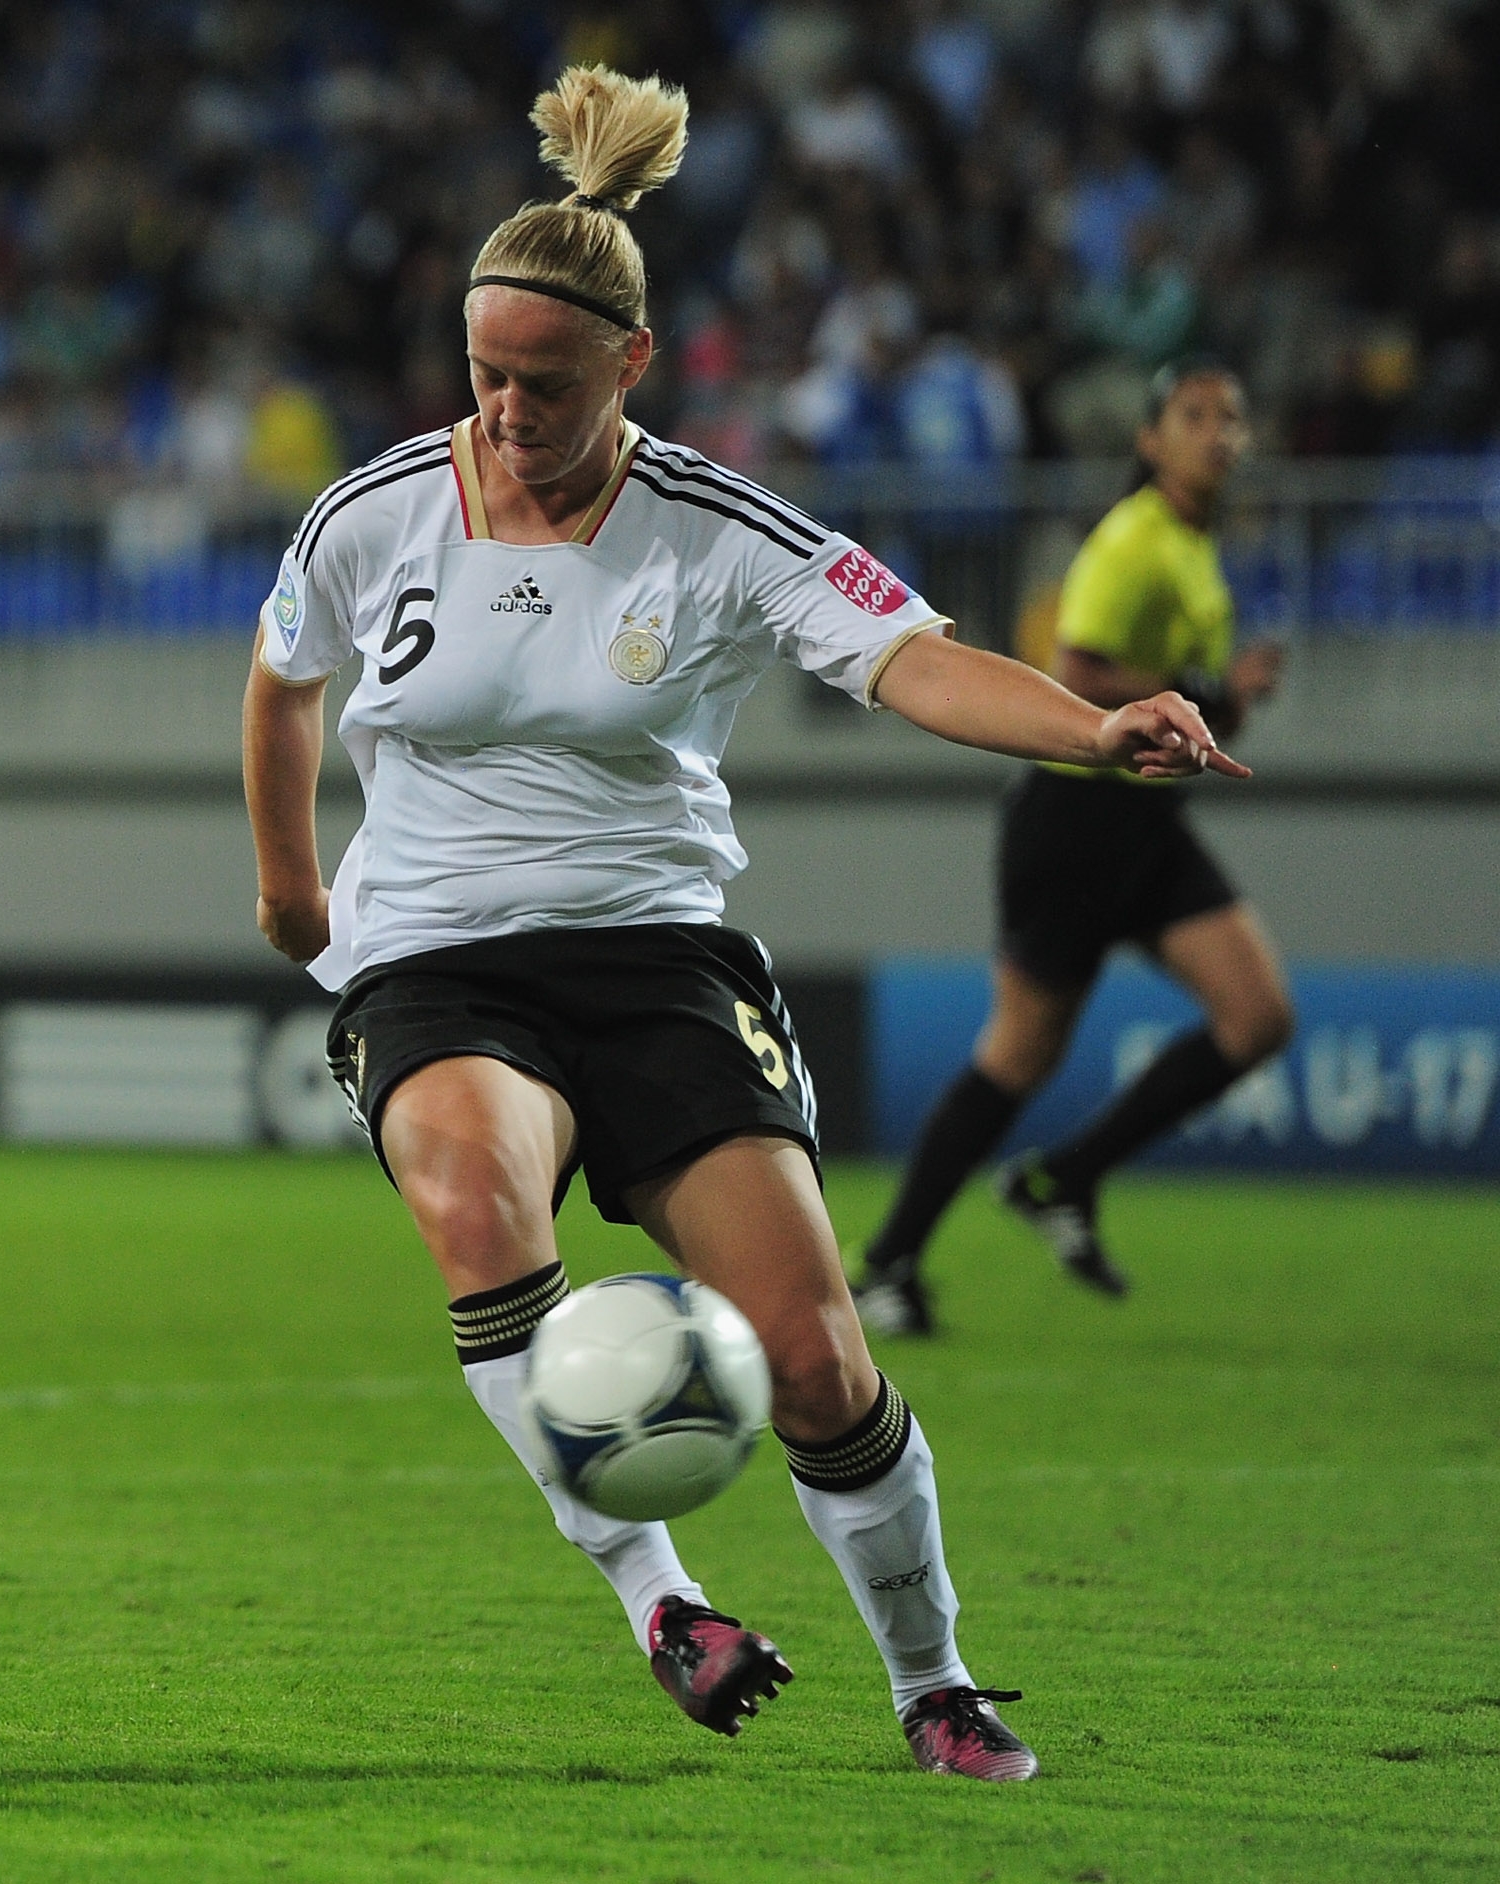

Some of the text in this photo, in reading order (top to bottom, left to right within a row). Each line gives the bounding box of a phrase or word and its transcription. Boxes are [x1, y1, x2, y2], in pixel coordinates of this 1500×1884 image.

[490, 599, 552, 615] adidas
[835, 550, 867, 592] LIVE
[379, 588, 435, 685] 5
[734, 1000, 789, 1090] 5
[1303, 1022, 1499, 1152] U-17
